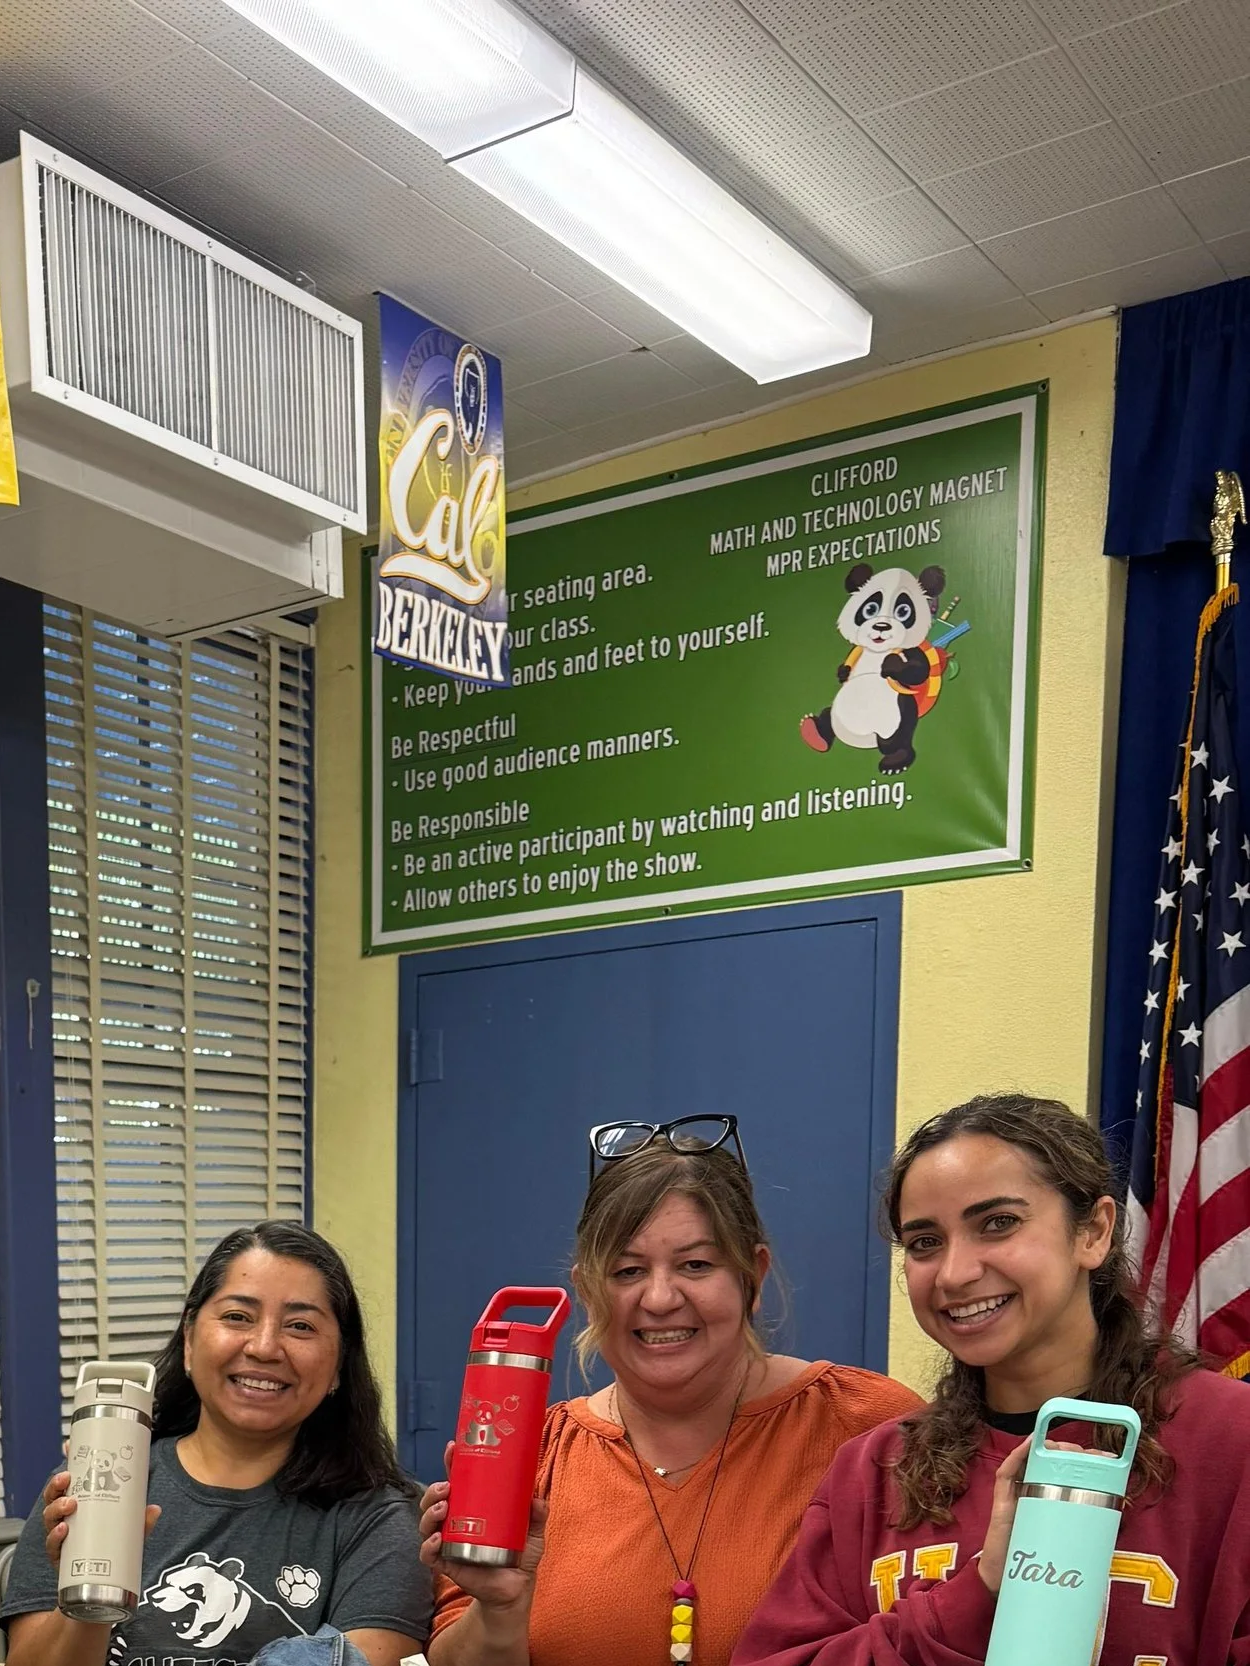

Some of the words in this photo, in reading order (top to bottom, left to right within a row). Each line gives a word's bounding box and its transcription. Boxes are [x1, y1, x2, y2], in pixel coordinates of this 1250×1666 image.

[384, 408, 501, 592] Cal
[811, 456, 898, 497] CLIFFORD
[710, 525, 755, 555] MATH
[761, 516, 796, 544] AND
[802, 486, 924, 534] TECHNOLOGY
[930, 466, 1008, 506] MAGNET
[766, 551, 802, 578] MPR
[808, 519, 942, 569] EXPECTATIONS
[524, 575, 595, 609] seating
[602, 563, 653, 592] area.
[376, 581, 507, 682] BERKELEY
[541, 615, 596, 643] class.
[404, 683, 448, 708] Keep
[454, 678, 493, 704] you
[512, 658, 557, 687] ands
[563, 647, 598, 677] and
[604, 638, 645, 669] feet
[650, 634, 671, 659] to
[677, 612, 770, 661] yourself.
[391, 736, 412, 760] Be
[418, 713, 517, 755] Respectful
[404, 769, 436, 793] Use
[442, 756, 488, 792] good
[494, 744, 581, 778] audience
[587, 726, 680, 762] manners.
[391, 819, 412, 844] Be
[418, 800, 530, 839] Responsible
[404, 853, 425, 877] Be
[431, 851, 452, 872] an
[458, 840, 513, 870] active
[519, 820, 625, 865] participant
[631, 817, 655, 847] by
[660, 800, 755, 838] watching
[761, 791, 800, 822] and
[806, 778, 913, 816] listening.
[403, 888, 452, 913] Allow
[457, 878, 517, 905] others
[523, 872, 542, 895] to
[548, 863, 600, 895] enjoy
[606, 857, 638, 884] the
[644, 851, 702, 879] show.
[74, 1561, 109, 1574] YETI
[1008, 1550, 1084, 1589] Tara
